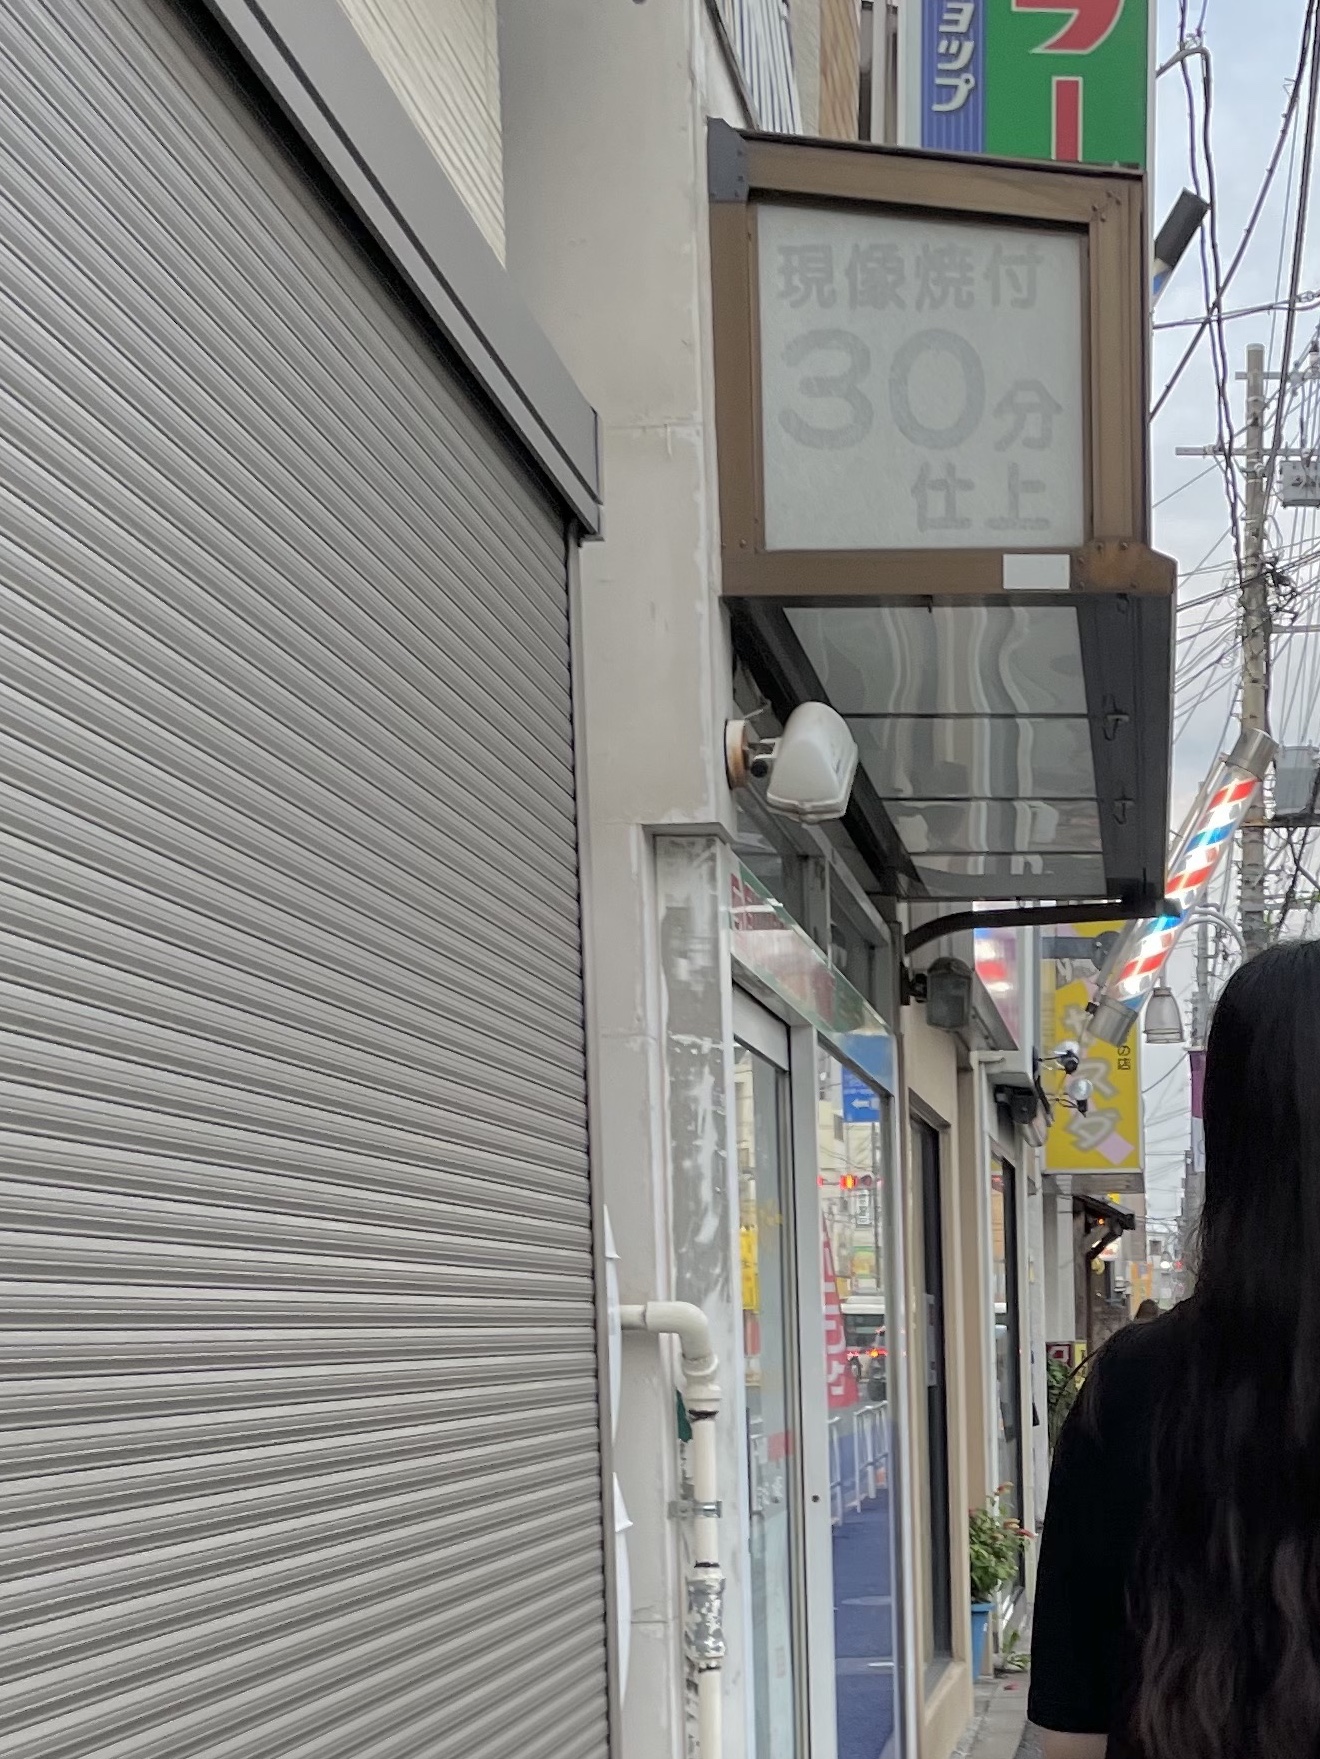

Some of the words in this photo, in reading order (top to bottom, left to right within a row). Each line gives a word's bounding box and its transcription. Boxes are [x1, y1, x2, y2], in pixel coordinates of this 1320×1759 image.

[777, 242, 1047, 313] 現像焼付
[777, 327, 1063, 453] 30分
[910, 460, 1051, 534] 仕上
